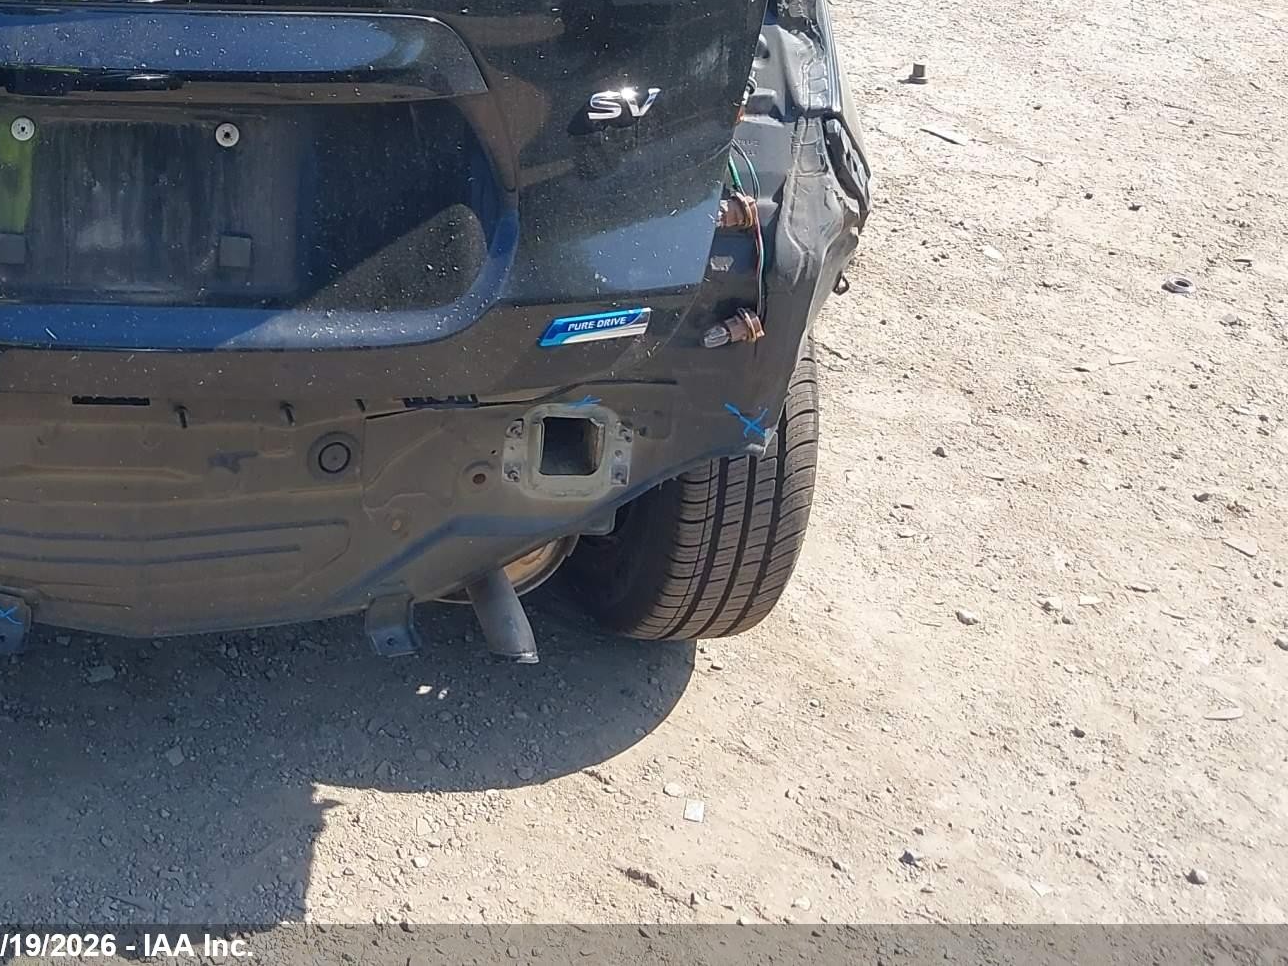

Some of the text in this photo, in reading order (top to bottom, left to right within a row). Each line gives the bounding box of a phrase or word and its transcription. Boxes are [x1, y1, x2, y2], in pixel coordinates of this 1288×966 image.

[587, 87, 661, 120] SV
[567, 316, 628, 332] PURE DRIVE
